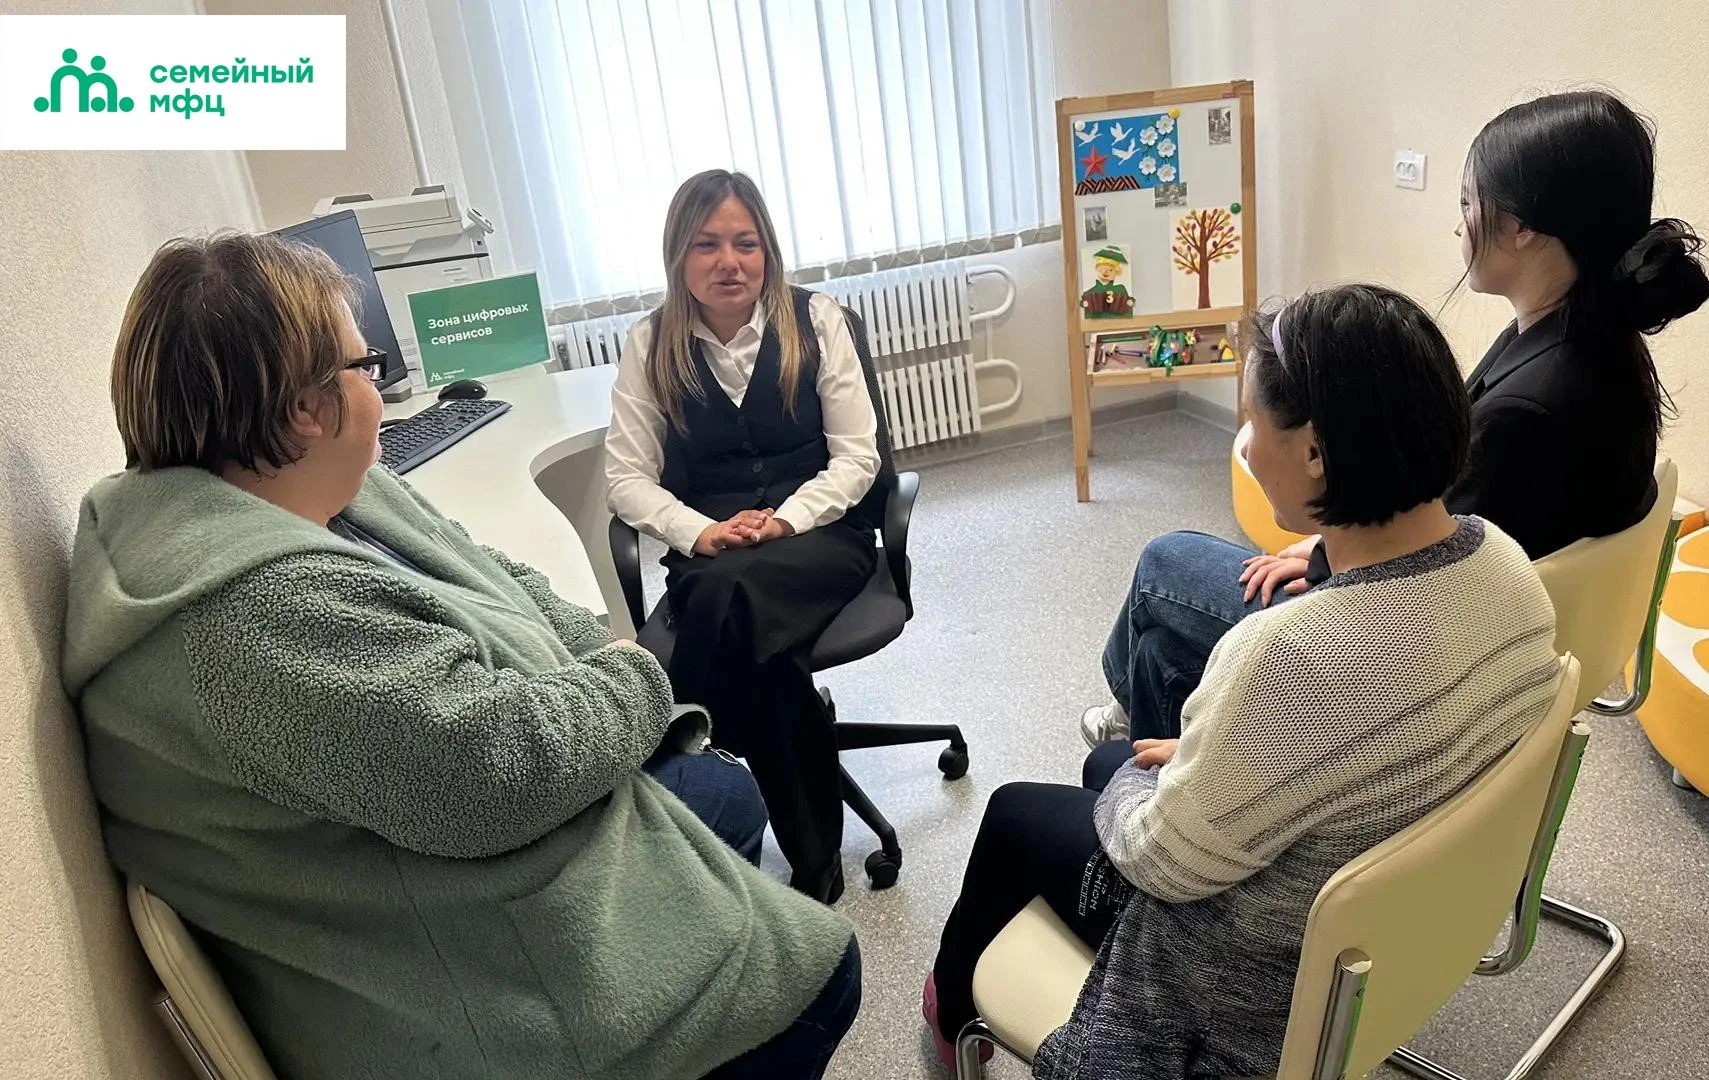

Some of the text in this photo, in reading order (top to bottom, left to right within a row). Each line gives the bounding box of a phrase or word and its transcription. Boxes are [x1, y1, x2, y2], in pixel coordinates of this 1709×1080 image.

[1106, 290, 1114, 304] 3
[427, 303, 529, 329] Зона цифровых
[430, 326, 493, 345] сервисов
